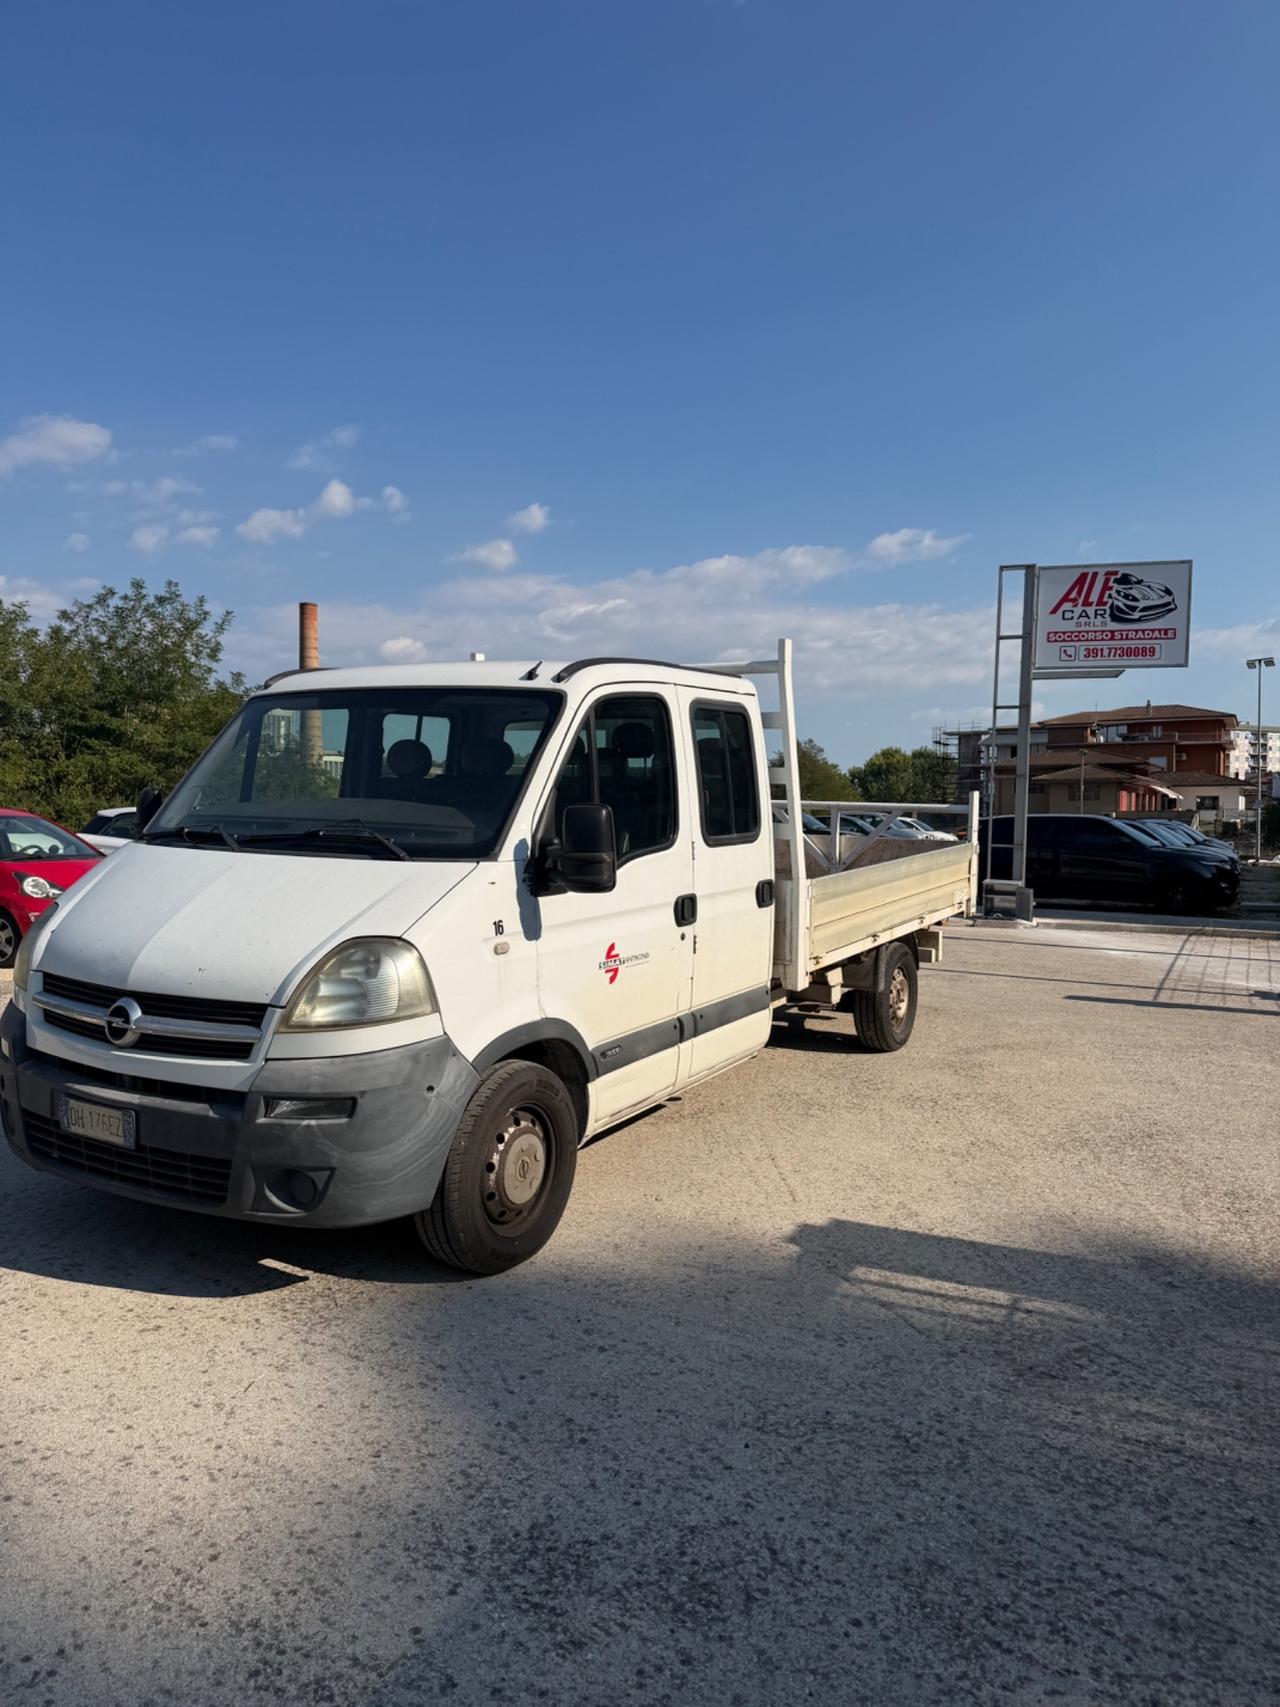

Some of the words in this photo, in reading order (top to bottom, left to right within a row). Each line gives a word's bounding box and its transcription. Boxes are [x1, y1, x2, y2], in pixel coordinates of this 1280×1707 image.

[1062, 608, 1108, 621] CAR
[1075, 620, 1108, 628] SRLS
[1049, 631, 1111, 641] SOCCORSO
[1114, 629, 1175, 640] STRADALE
[1084, 646, 1156, 659] 391.7730089
[492, 919, 504, 936] 16
